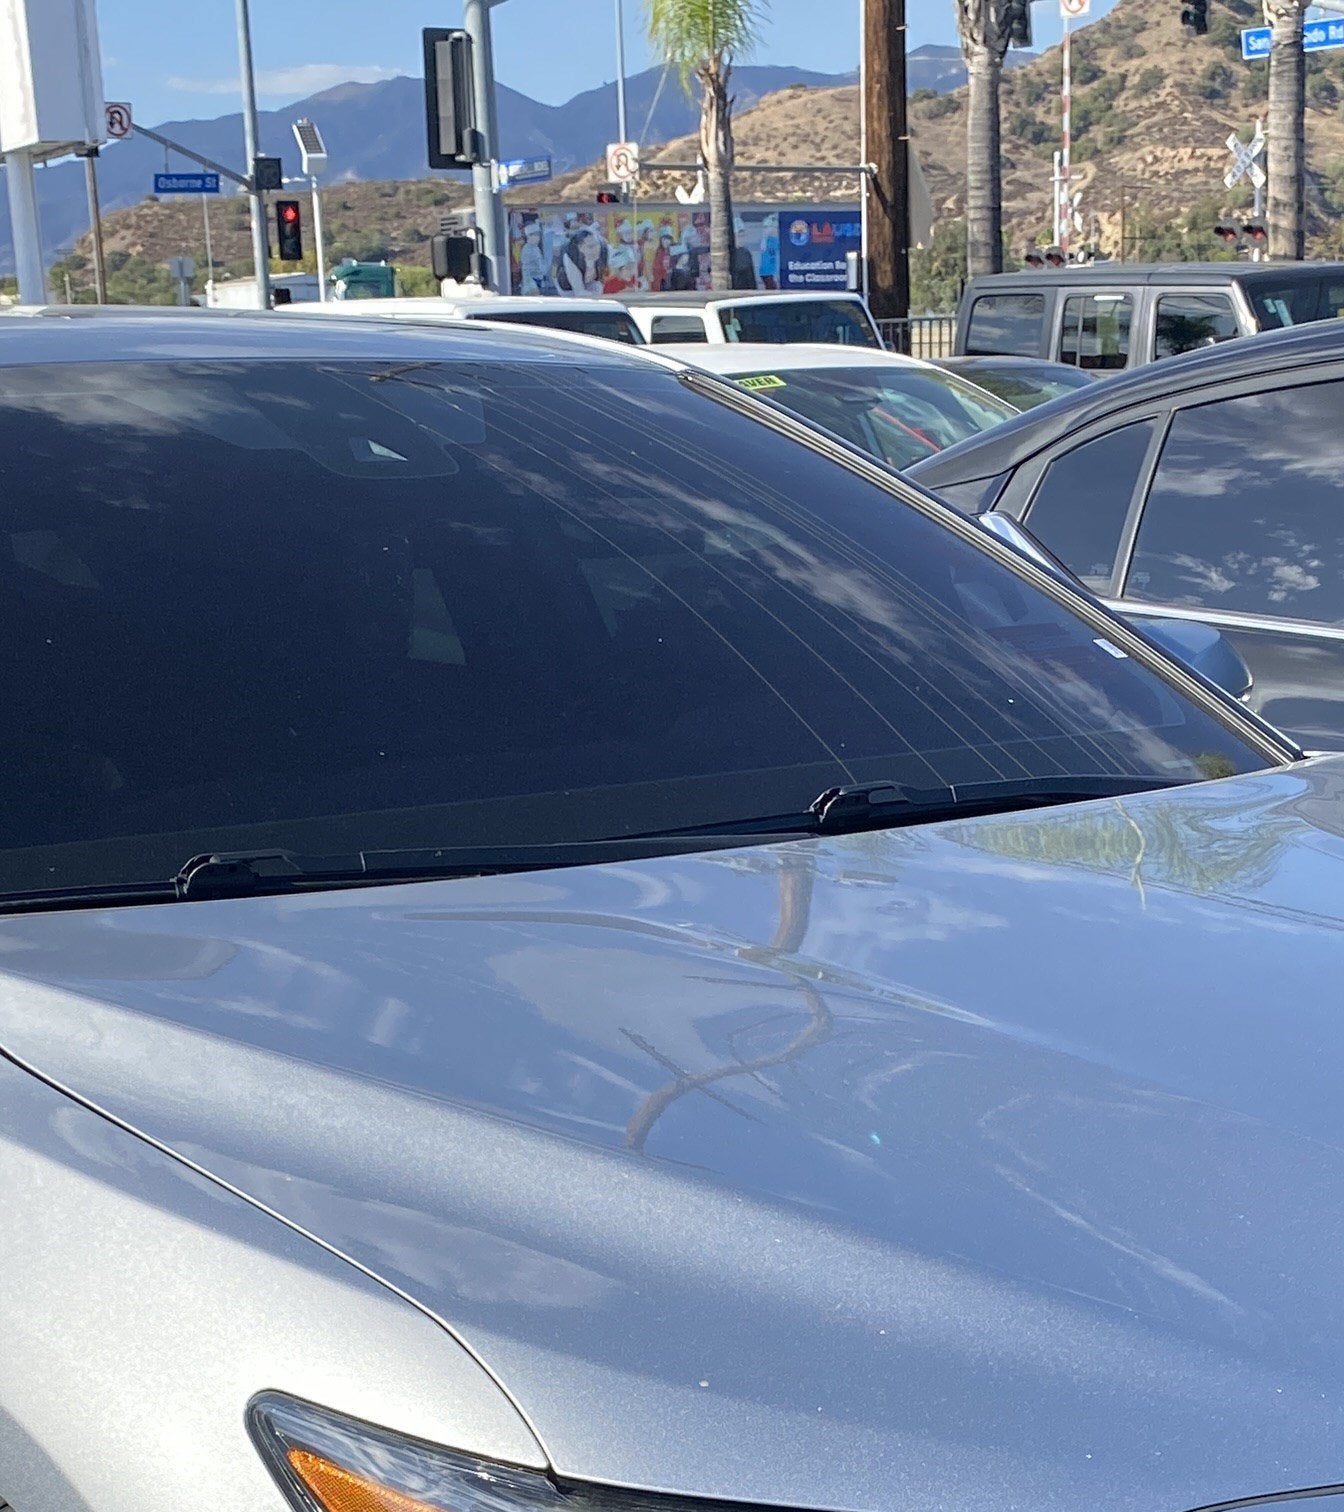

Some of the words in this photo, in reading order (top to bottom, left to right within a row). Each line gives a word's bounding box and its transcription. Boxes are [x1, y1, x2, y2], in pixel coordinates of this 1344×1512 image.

[158, 177, 202, 189] Osborne
[205, 177, 217, 188] St
[788, 261, 834, 271] Education
